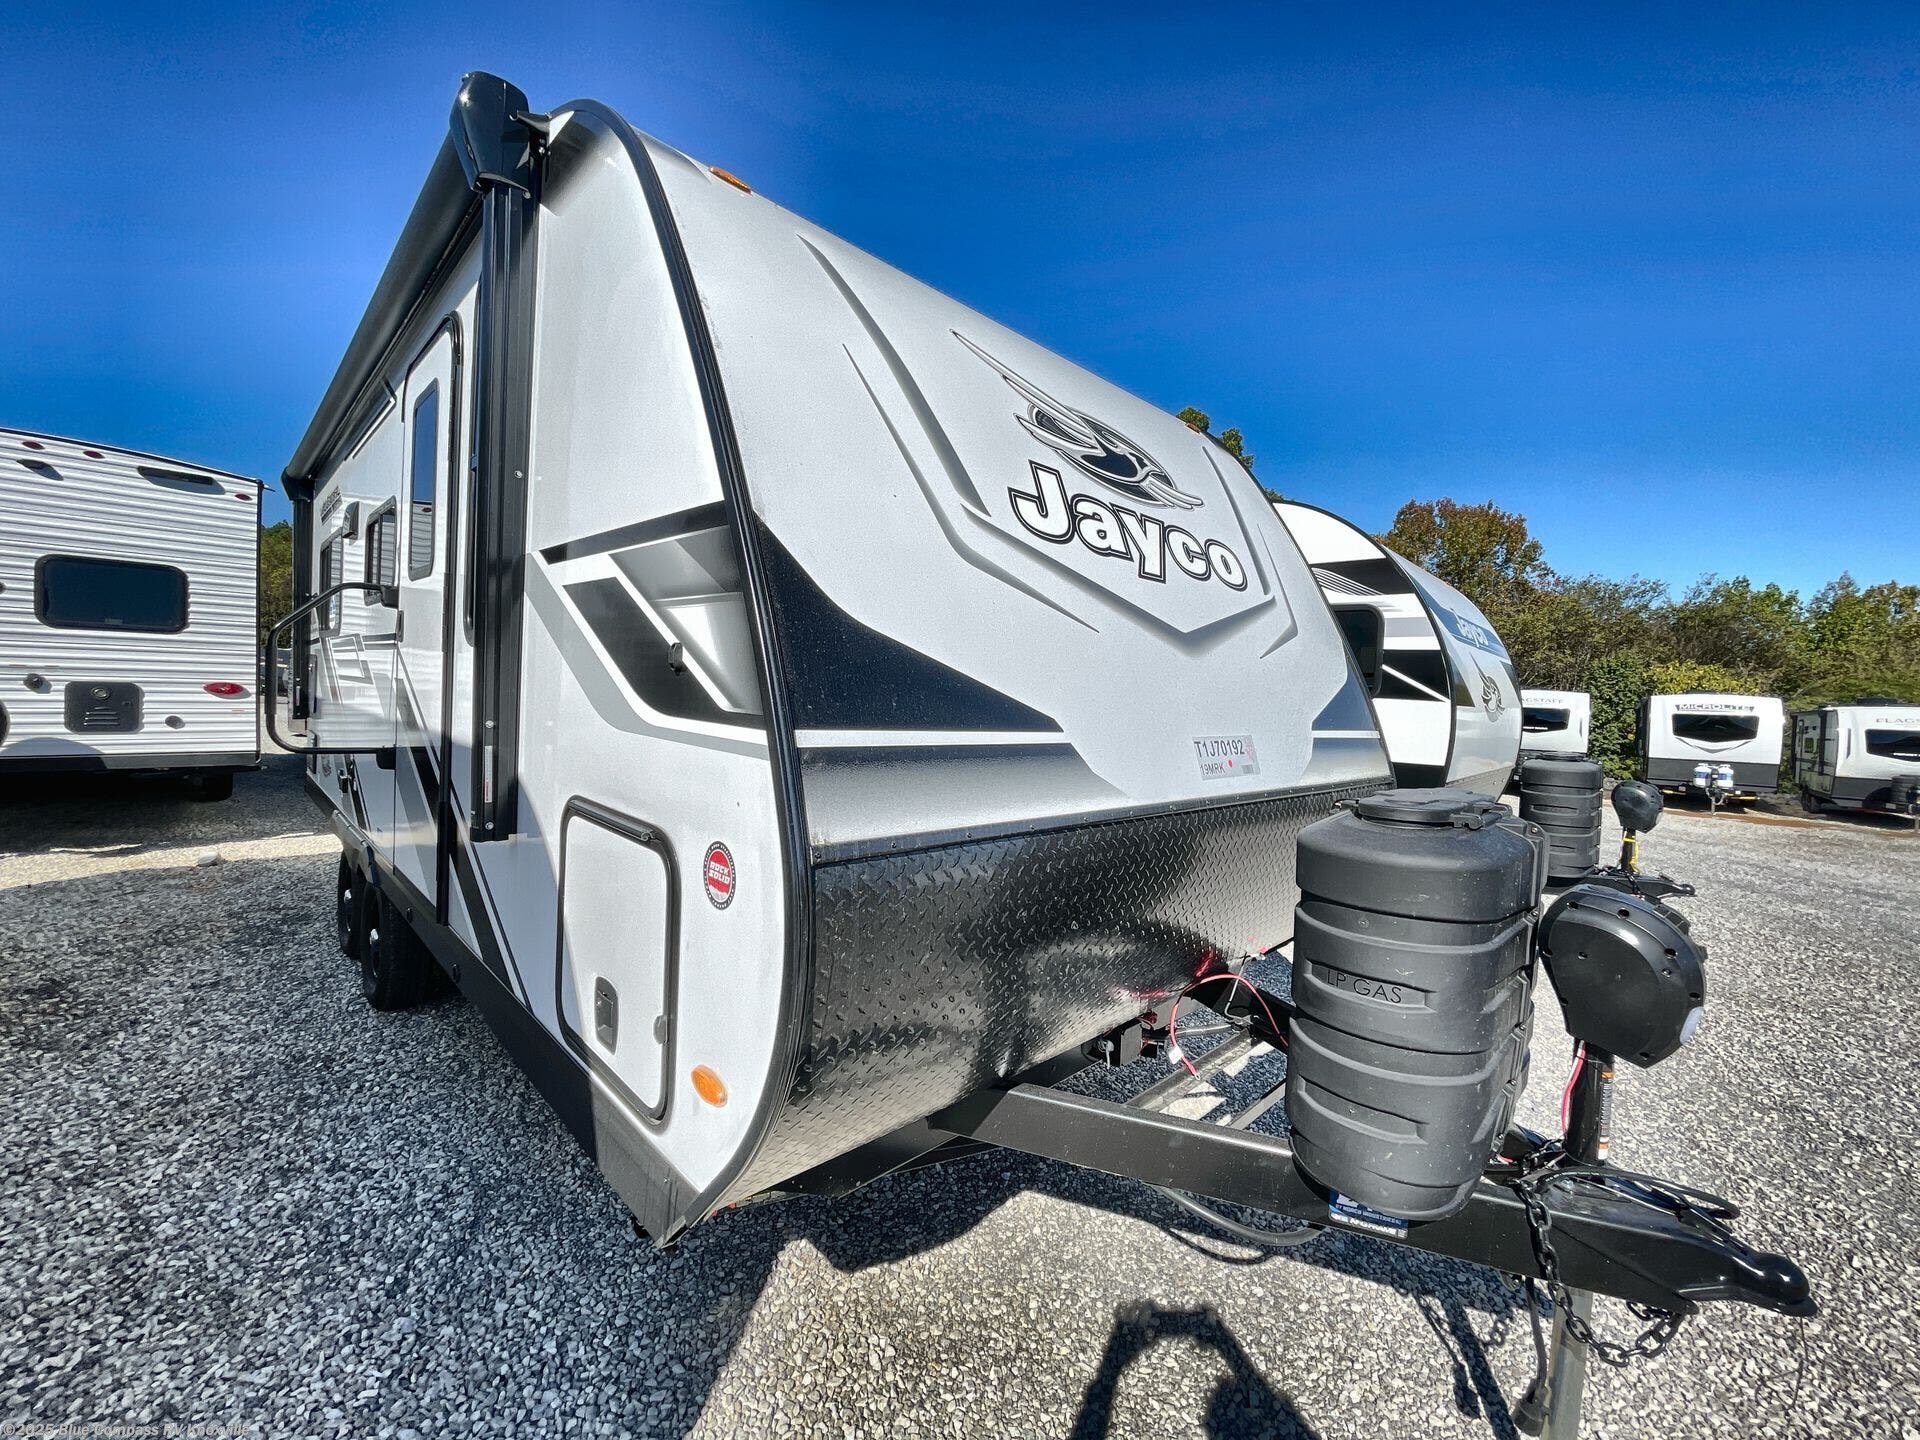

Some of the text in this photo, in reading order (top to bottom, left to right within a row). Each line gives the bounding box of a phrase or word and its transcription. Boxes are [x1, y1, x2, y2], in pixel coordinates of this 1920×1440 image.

[1007, 459, 1248, 592] Jayco
[1194, 740, 1246, 757] T1J70192
[1200, 762, 1226, 775] 19MRK
[710, 861, 729, 875] ROCK
[709, 870, 731, 884] SOLID
[1327, 969, 1402, 1004] LP GAS
